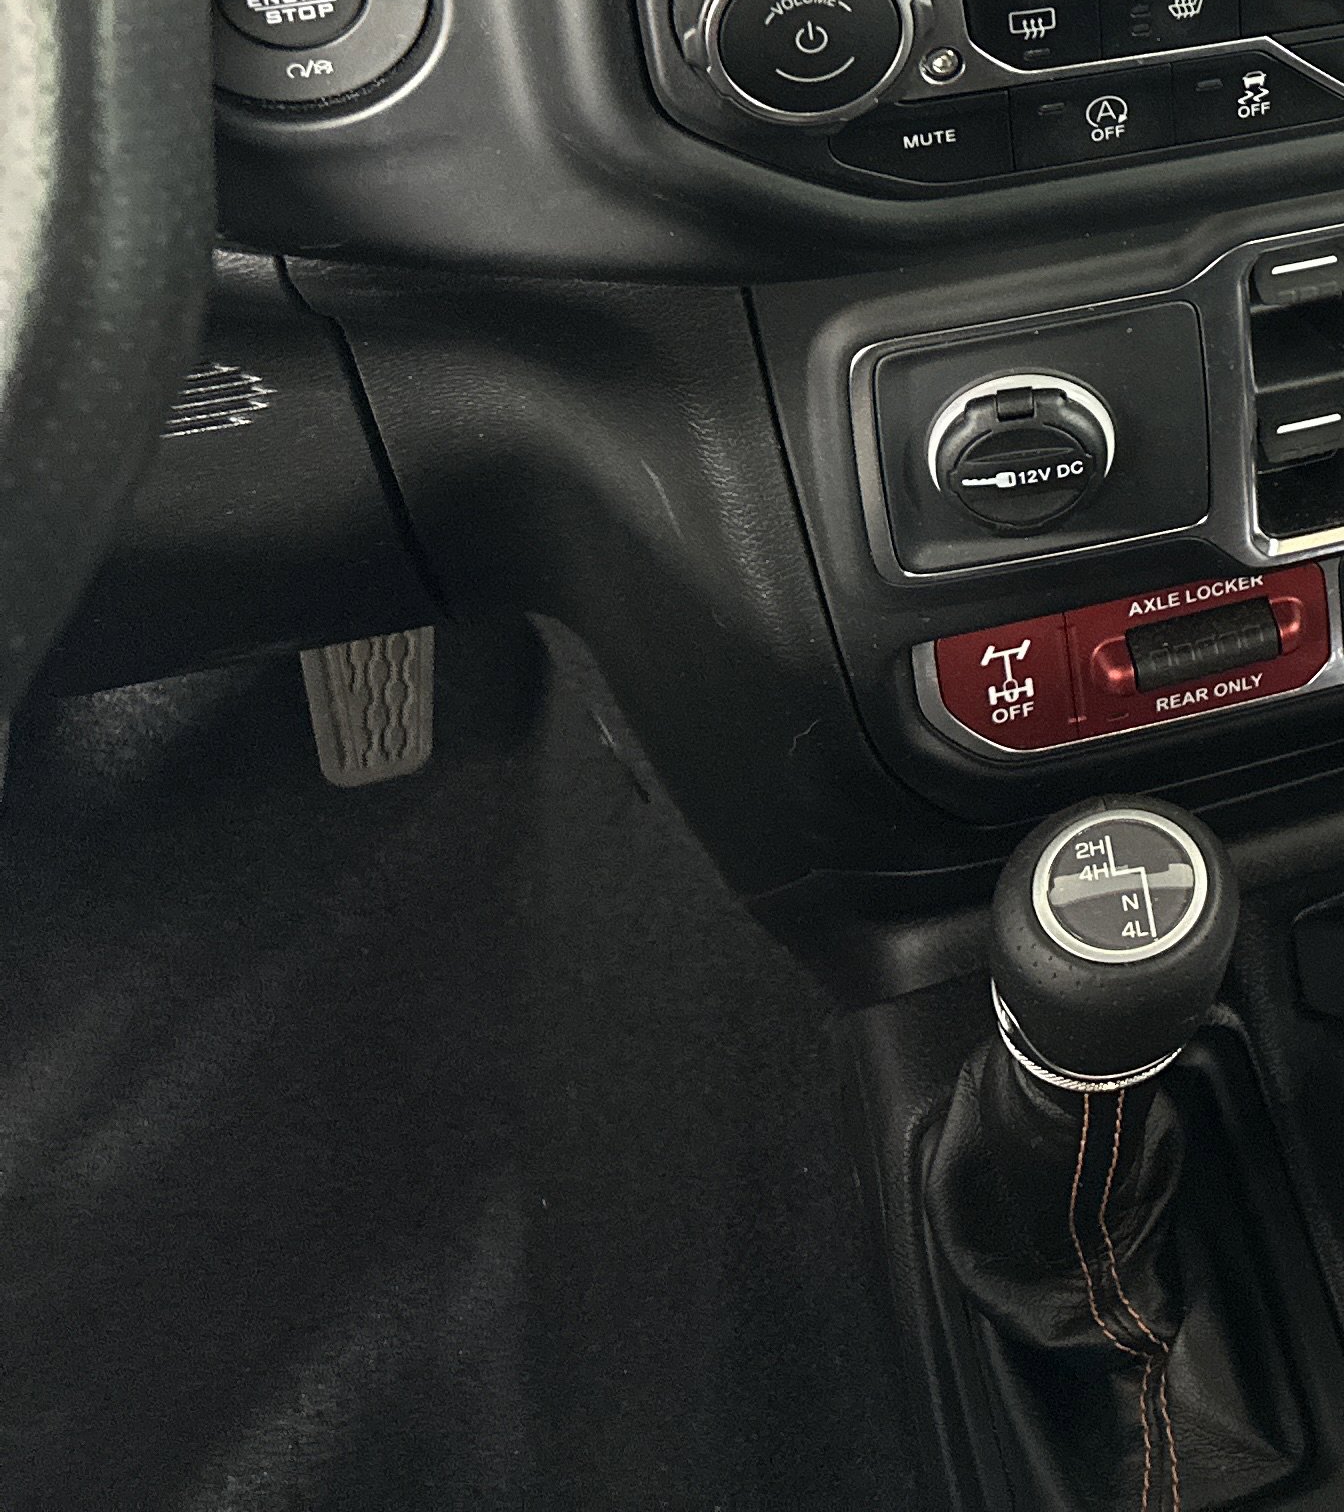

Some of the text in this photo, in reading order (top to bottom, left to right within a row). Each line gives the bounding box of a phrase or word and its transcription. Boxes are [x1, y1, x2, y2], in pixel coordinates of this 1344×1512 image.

[266, 3, 334, 24] STOP
[1237, 101, 1271, 120] OFF
[904, 129, 956, 149] MUTE
[1091, 124, 1126, 142] OFF
[1018, 460, 1084, 484] 12V DC
[1128, 575, 1264, 618] AXLE LOCKER
[1156, 673, 1263, 712] REAR ONLY
[992, 701, 1035, 724] OFF
[1075, 839, 1105, 859] 2H
[1079, 862, 1109, 881] 4H
[1121, 893, 1139, 911] N
[1121, 920, 1149, 938] 4L
